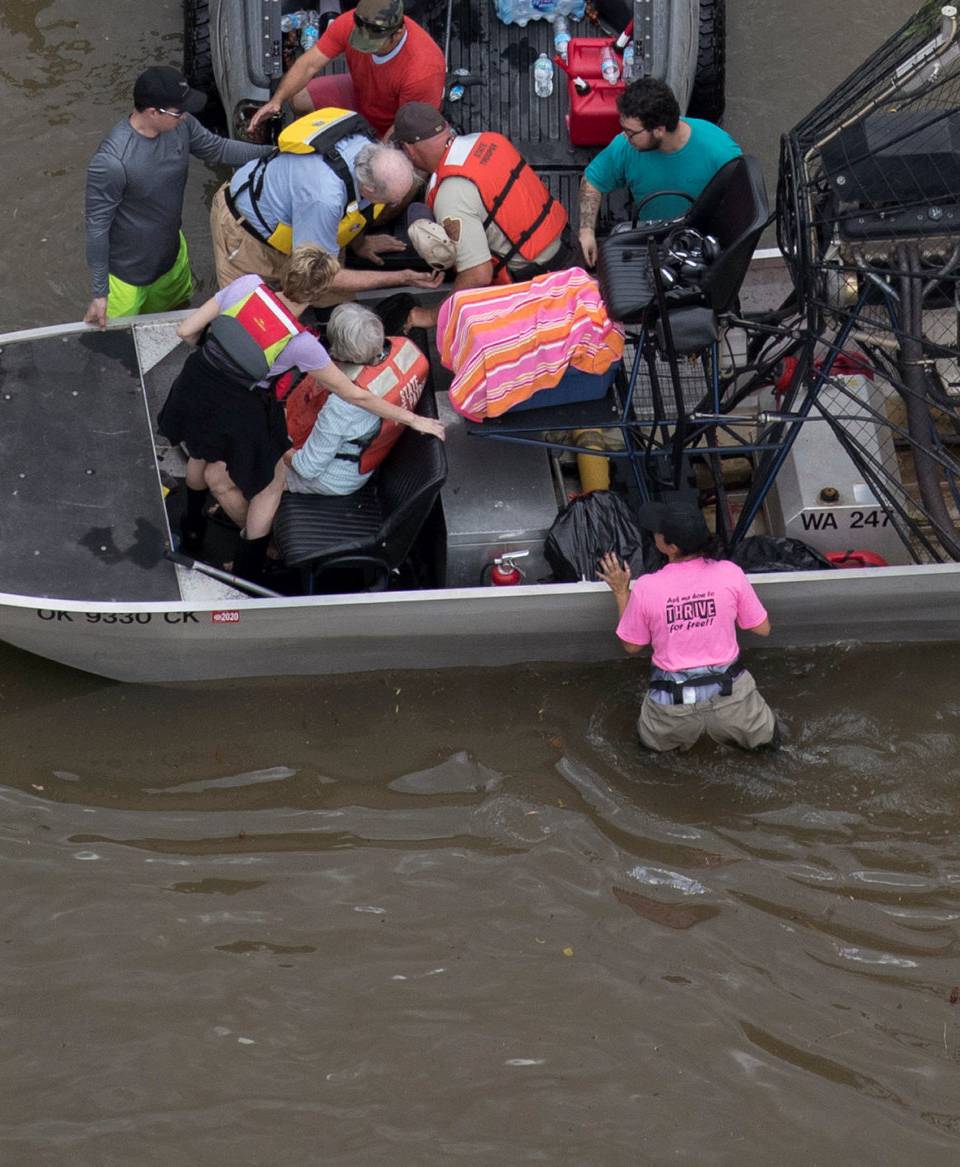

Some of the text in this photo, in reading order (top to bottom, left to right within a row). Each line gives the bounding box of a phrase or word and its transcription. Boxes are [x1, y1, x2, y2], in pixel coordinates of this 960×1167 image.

[801, 513, 838, 531] WA
[37, 609, 74, 622] OK
[164, 611, 200, 624] CK
[666, 599, 717, 624] THRIVE
[670, 624, 684, 633] for
